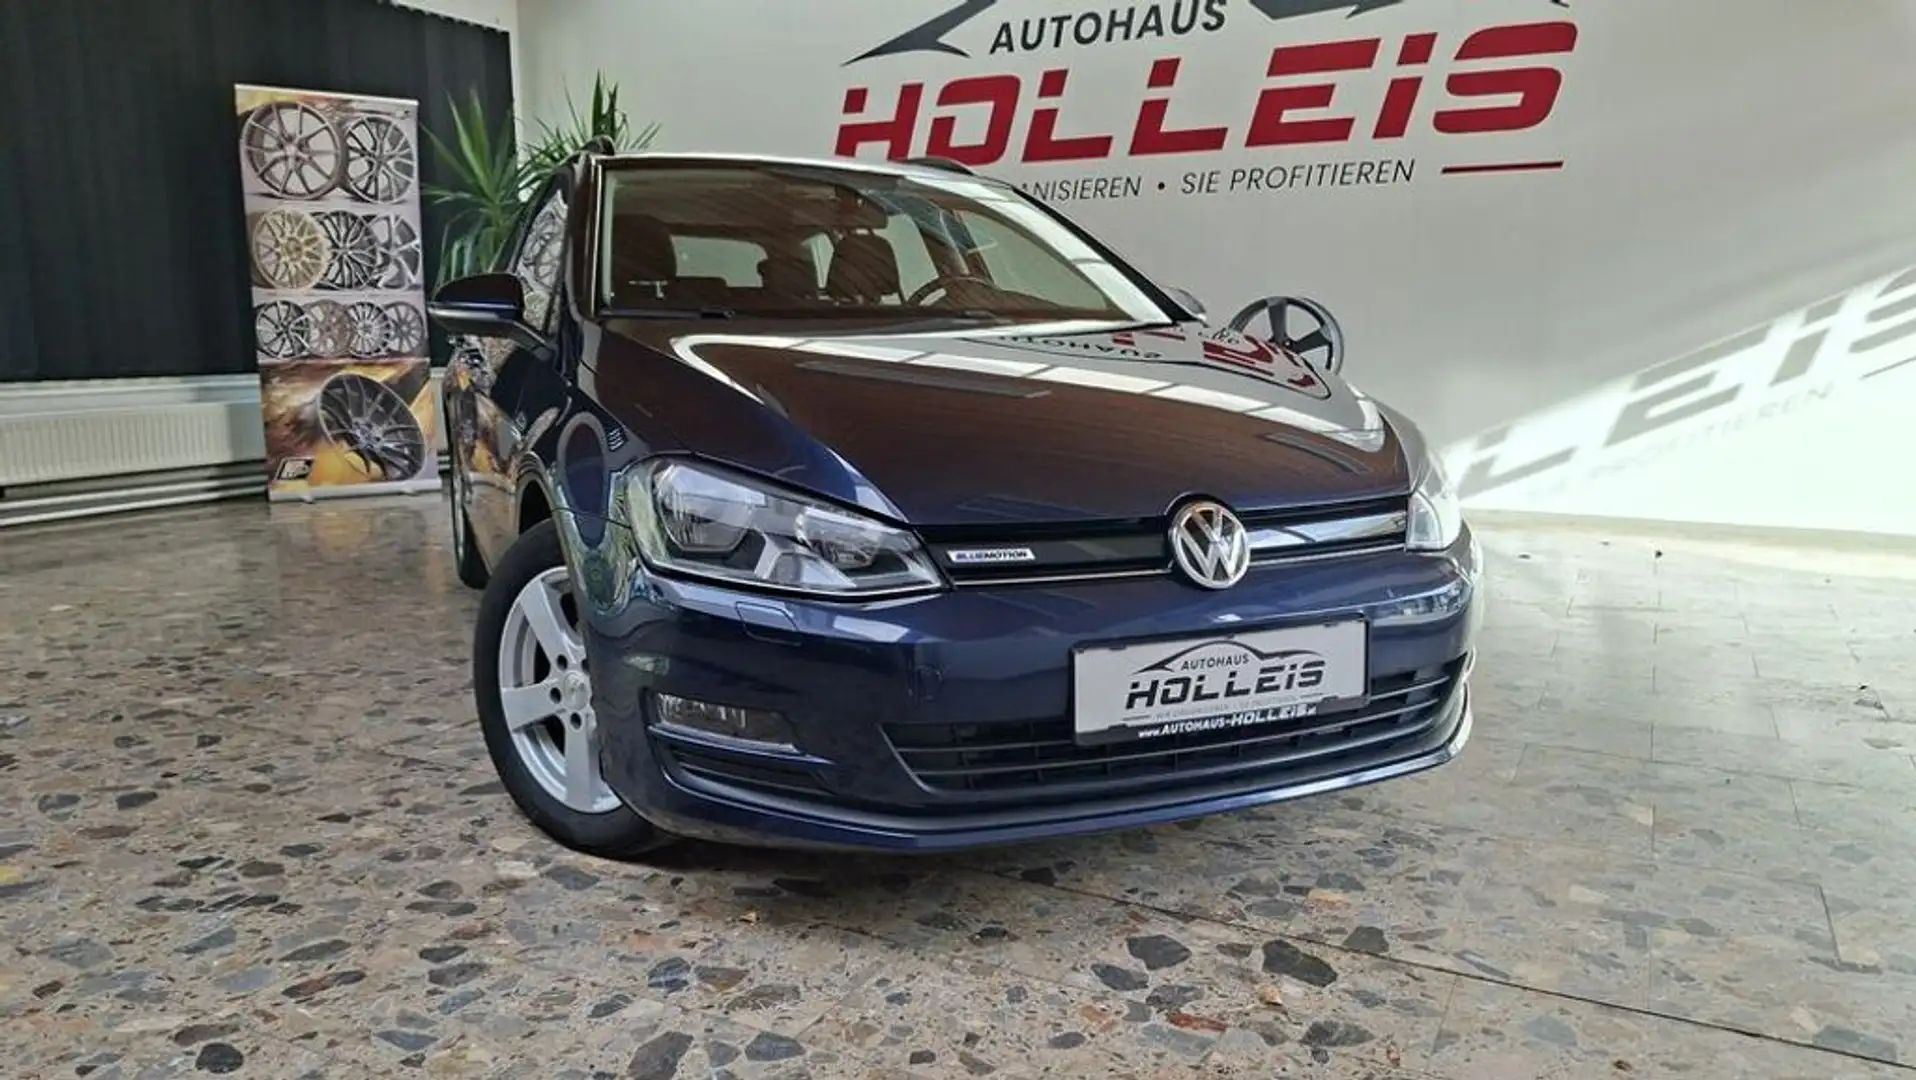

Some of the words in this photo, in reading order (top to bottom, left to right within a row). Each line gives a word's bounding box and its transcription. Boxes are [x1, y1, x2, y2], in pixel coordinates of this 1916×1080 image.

[989, 0, 1227, 55] AUTOHAUS
[834, 21, 1579, 167] HOLLEIS
[1181, 171, 1221, 195] SIE
[1228, 158, 1415, 192] PROFITIEREN
[1125, 660, 1325, 709] HOLLEIS
[1180, 653, 1249, 670] AUTOHAUS
